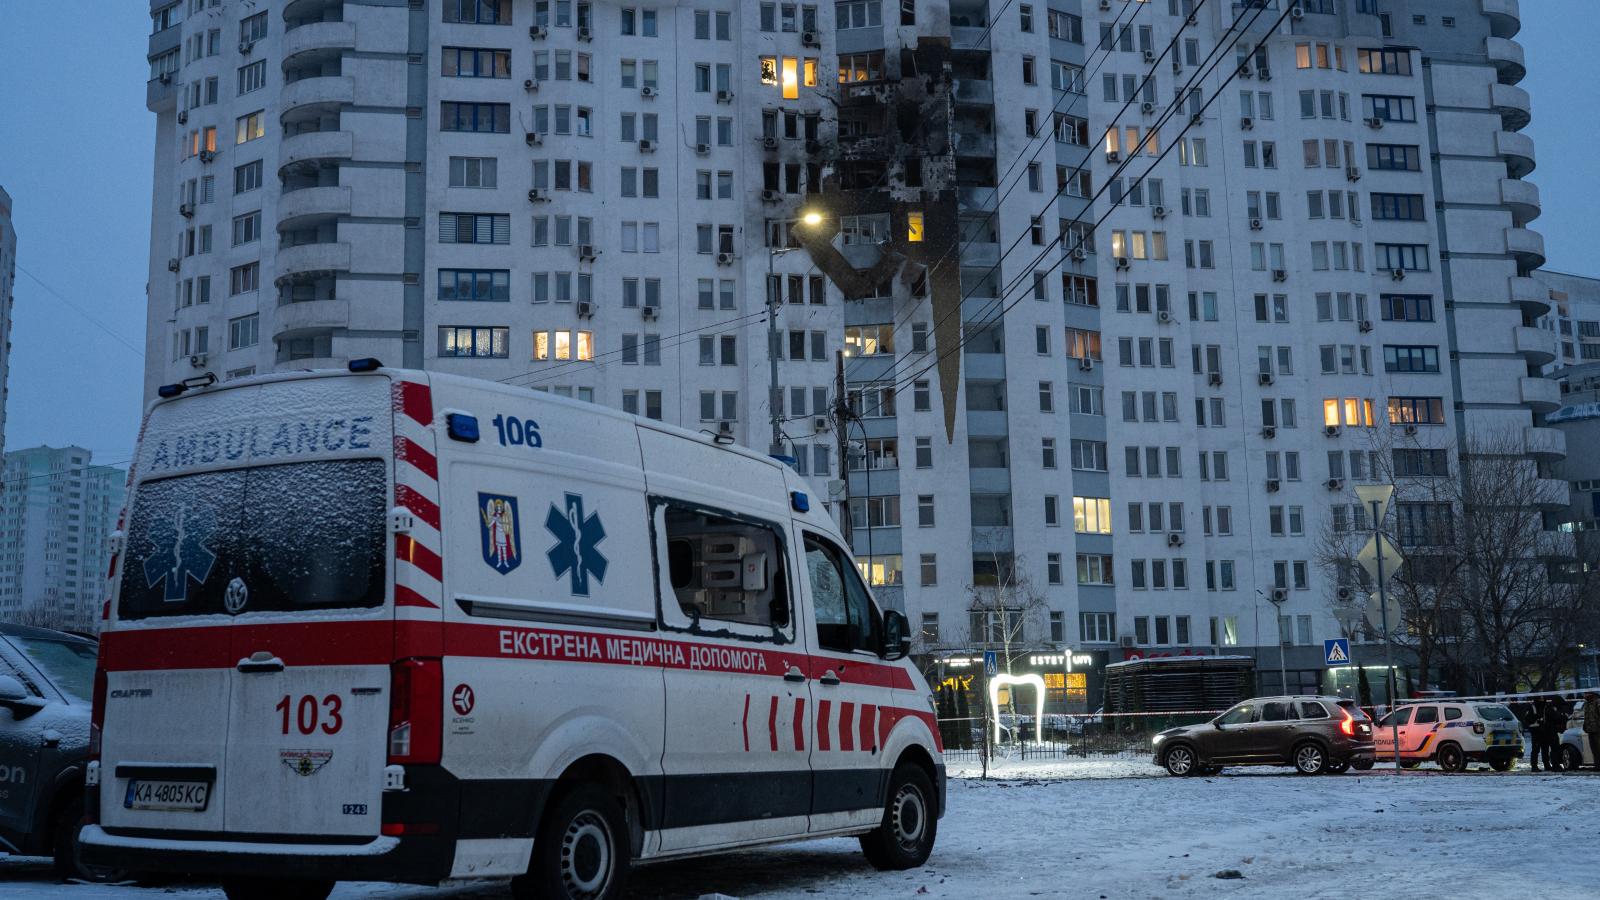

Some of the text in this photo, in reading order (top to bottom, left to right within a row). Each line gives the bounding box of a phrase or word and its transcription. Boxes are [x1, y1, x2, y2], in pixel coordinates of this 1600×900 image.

[151, 416, 373, 471] AMBULANCE
[492, 414, 543, 448] 106
[499, 630, 767, 671] ЕКСТРЕНА МЕДИЧНА ДОПОМОГА
[276, 694, 343, 735] 103
[135, 783, 205, 803] KA 4805 KC
[343, 805, 367, 814] 1243
